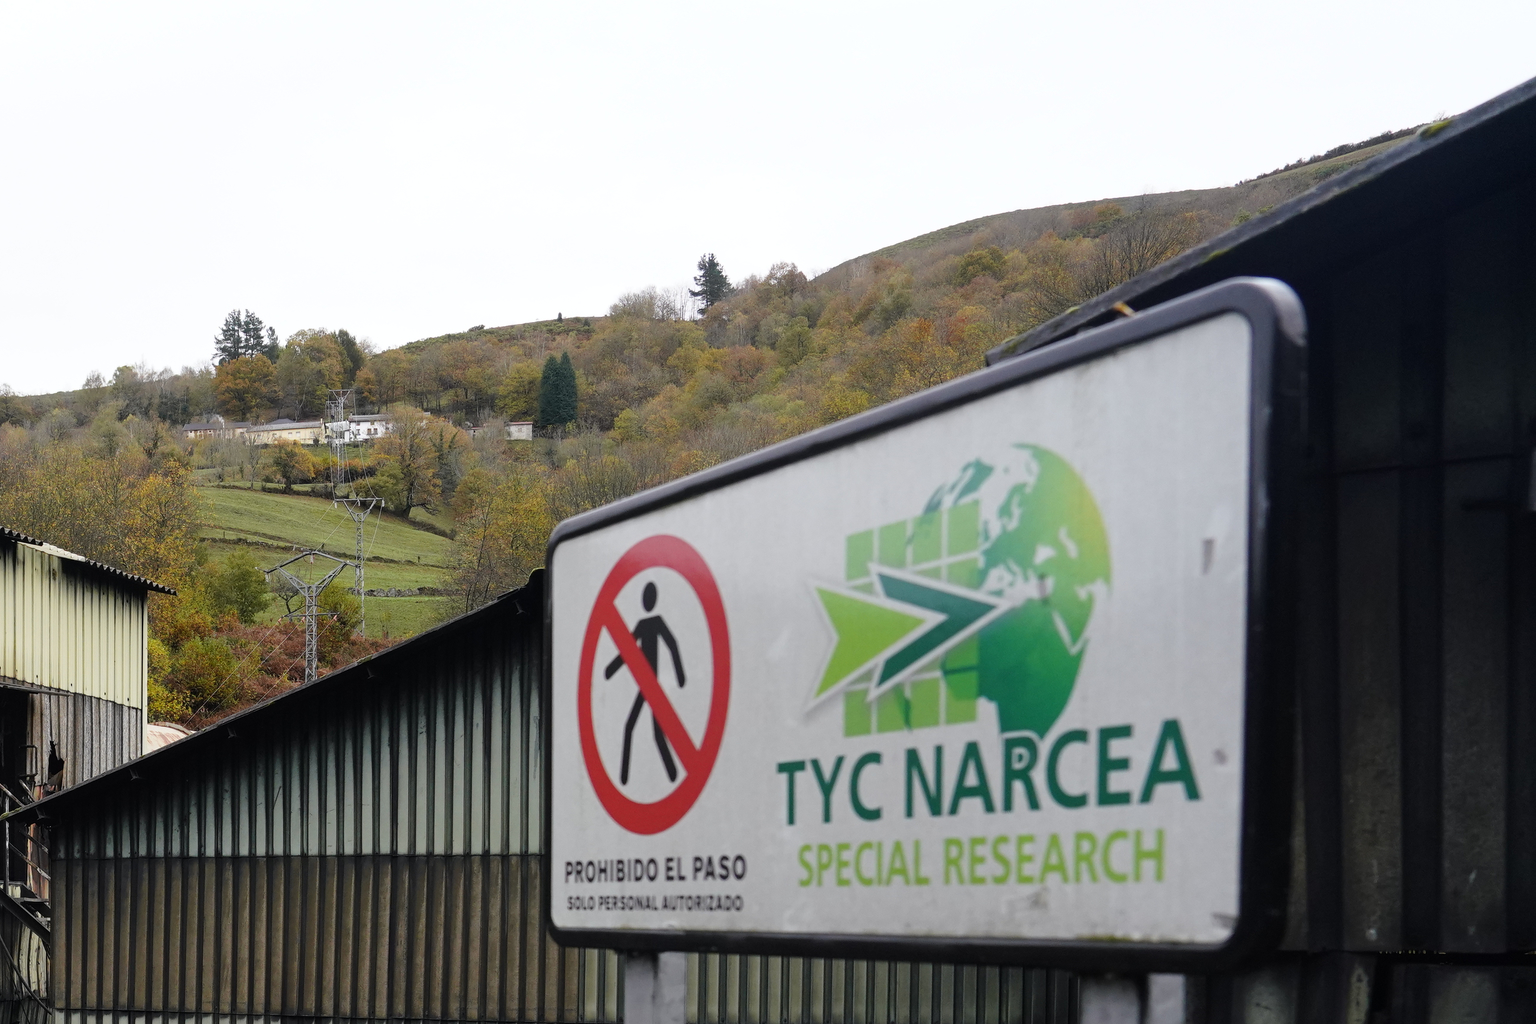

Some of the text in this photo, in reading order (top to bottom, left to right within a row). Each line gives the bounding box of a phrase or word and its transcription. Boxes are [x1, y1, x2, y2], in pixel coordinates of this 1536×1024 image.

[776, 718, 1202, 826] TYC NARCEA
[565, 854, 748, 883] PROHIBIDO EL PASO
[798, 828, 1165, 887] SPECIAL RESEARCH
[566, 895, 745, 912] SOLO PERSONAL AUTORIZADO
